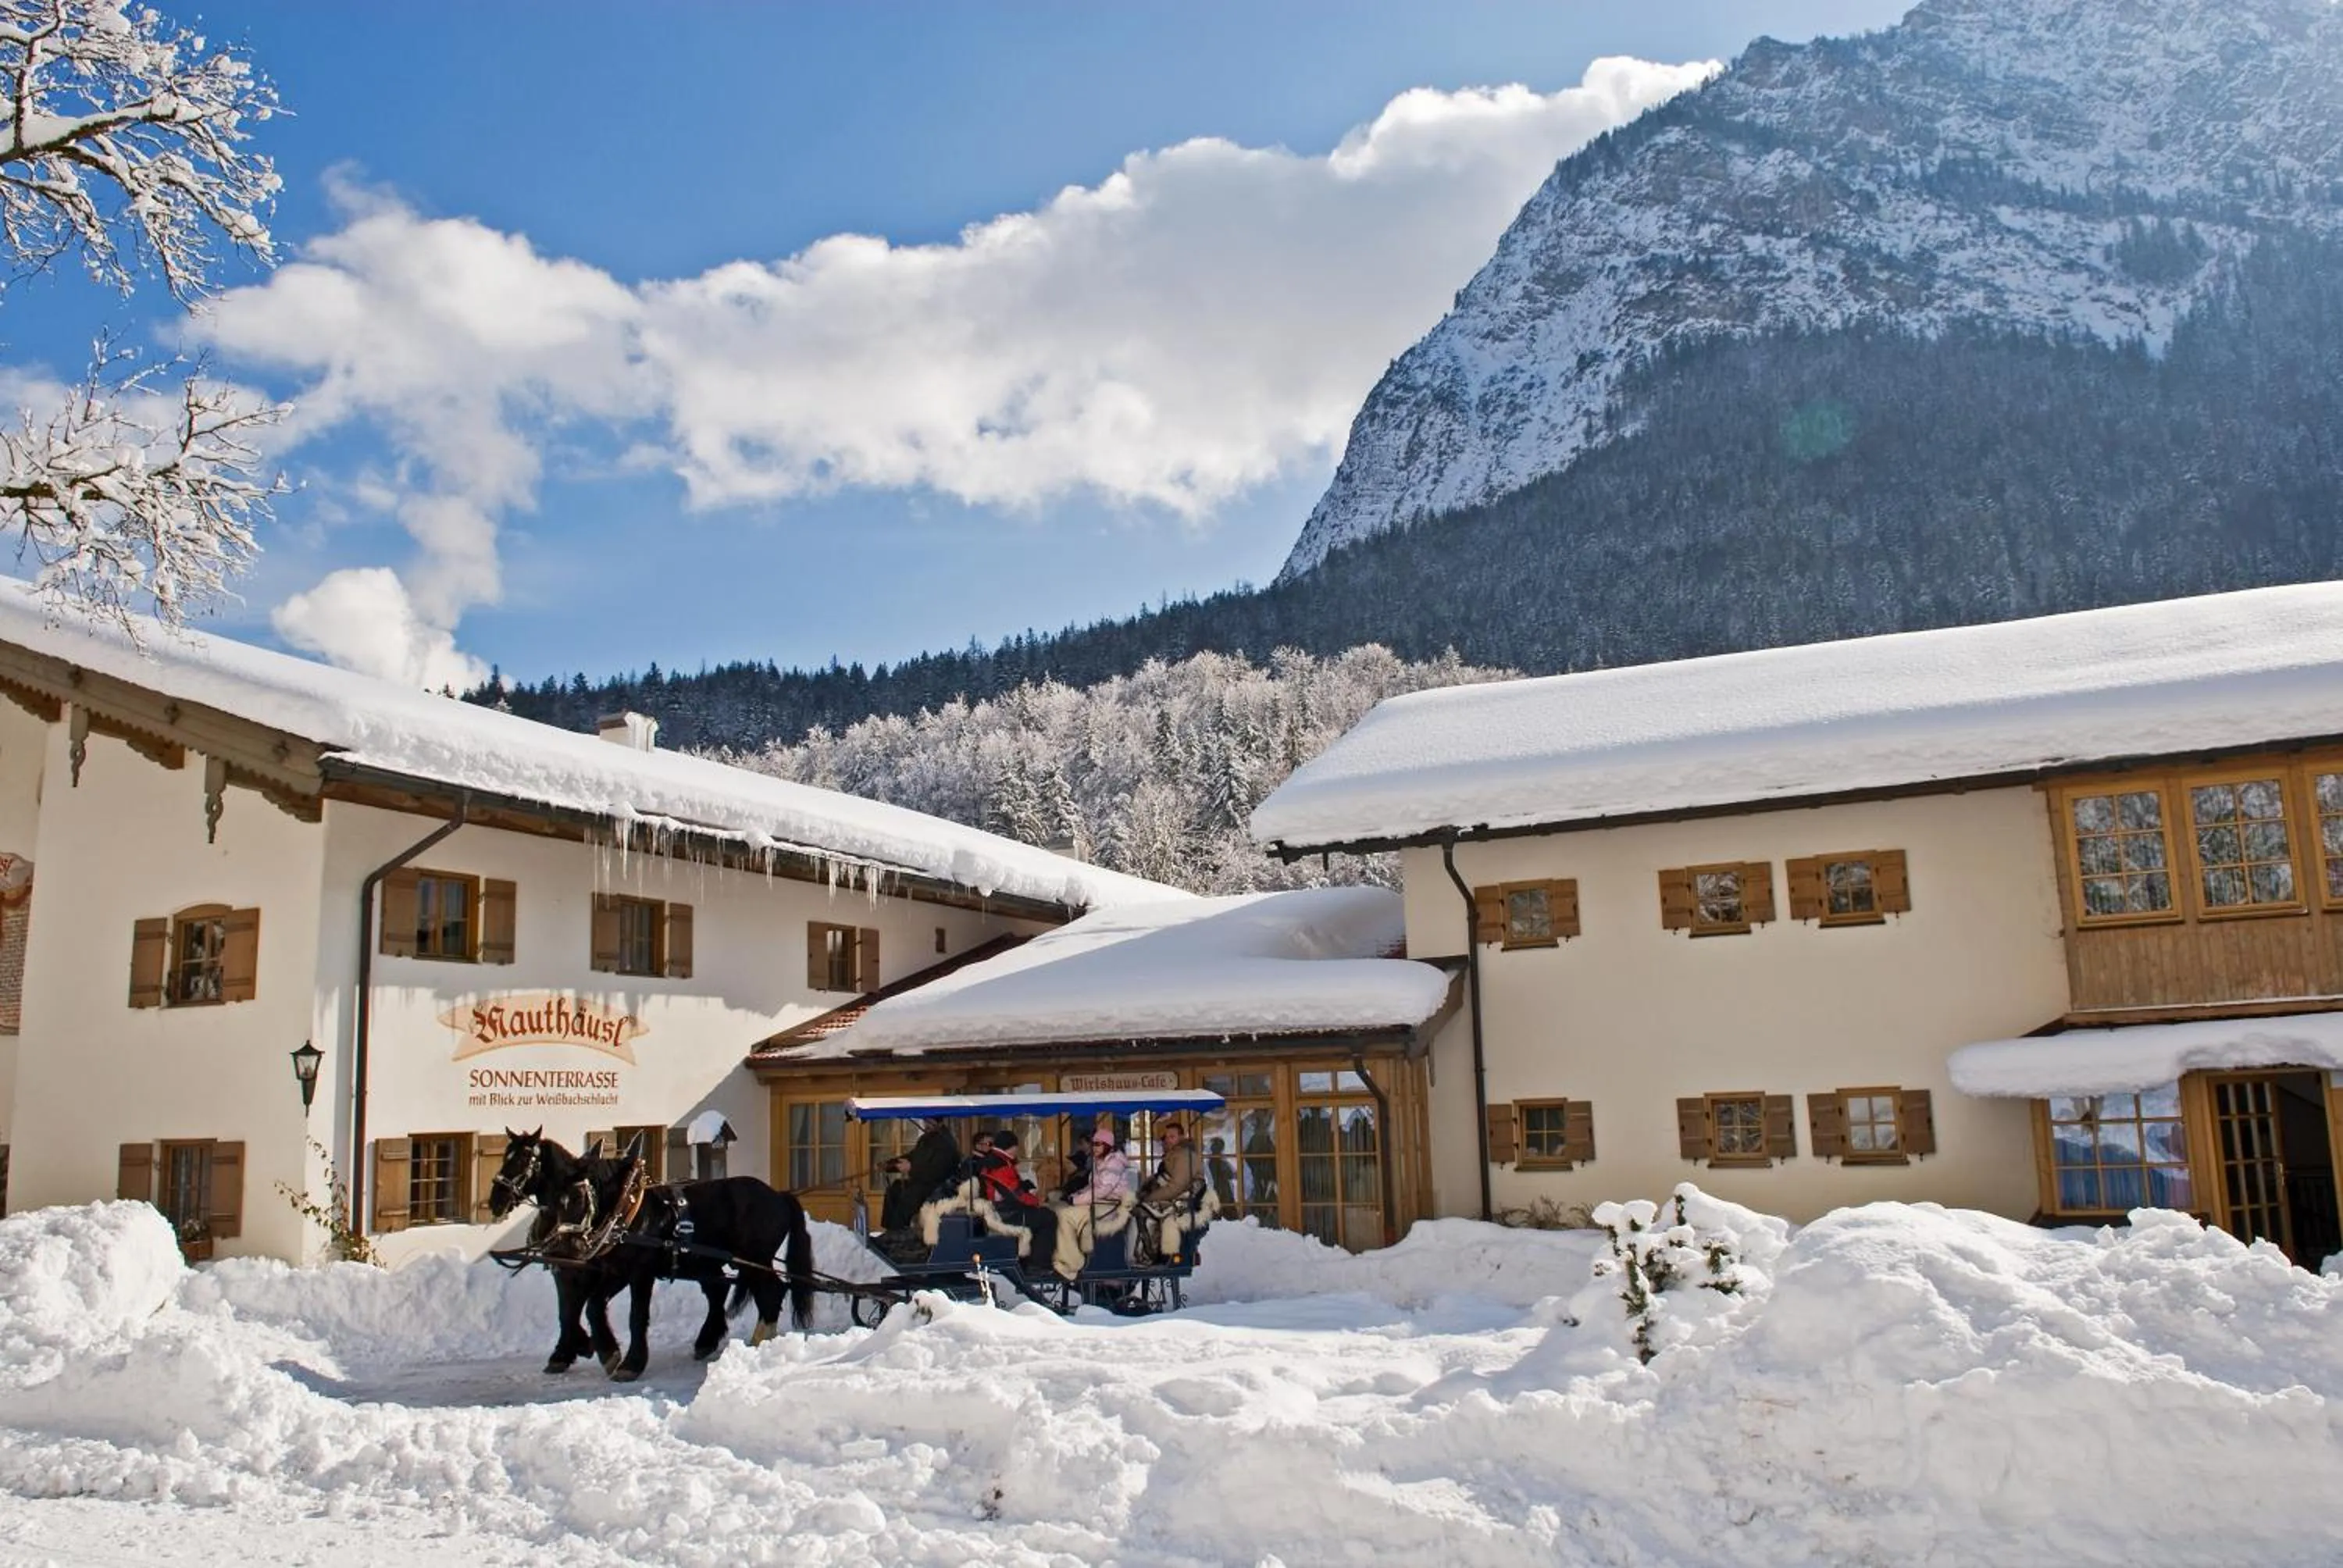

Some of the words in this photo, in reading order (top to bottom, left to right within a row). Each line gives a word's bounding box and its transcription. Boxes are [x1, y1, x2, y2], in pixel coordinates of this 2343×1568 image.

[472, 996, 628, 1046] Mauthäusl
[469, 1069, 618, 1089] SONNENTERRASSE
[469, 1094, 486, 1106] mit
[490, 1093, 515, 1106] Blick
[517, 1096, 533, 1106] zur
